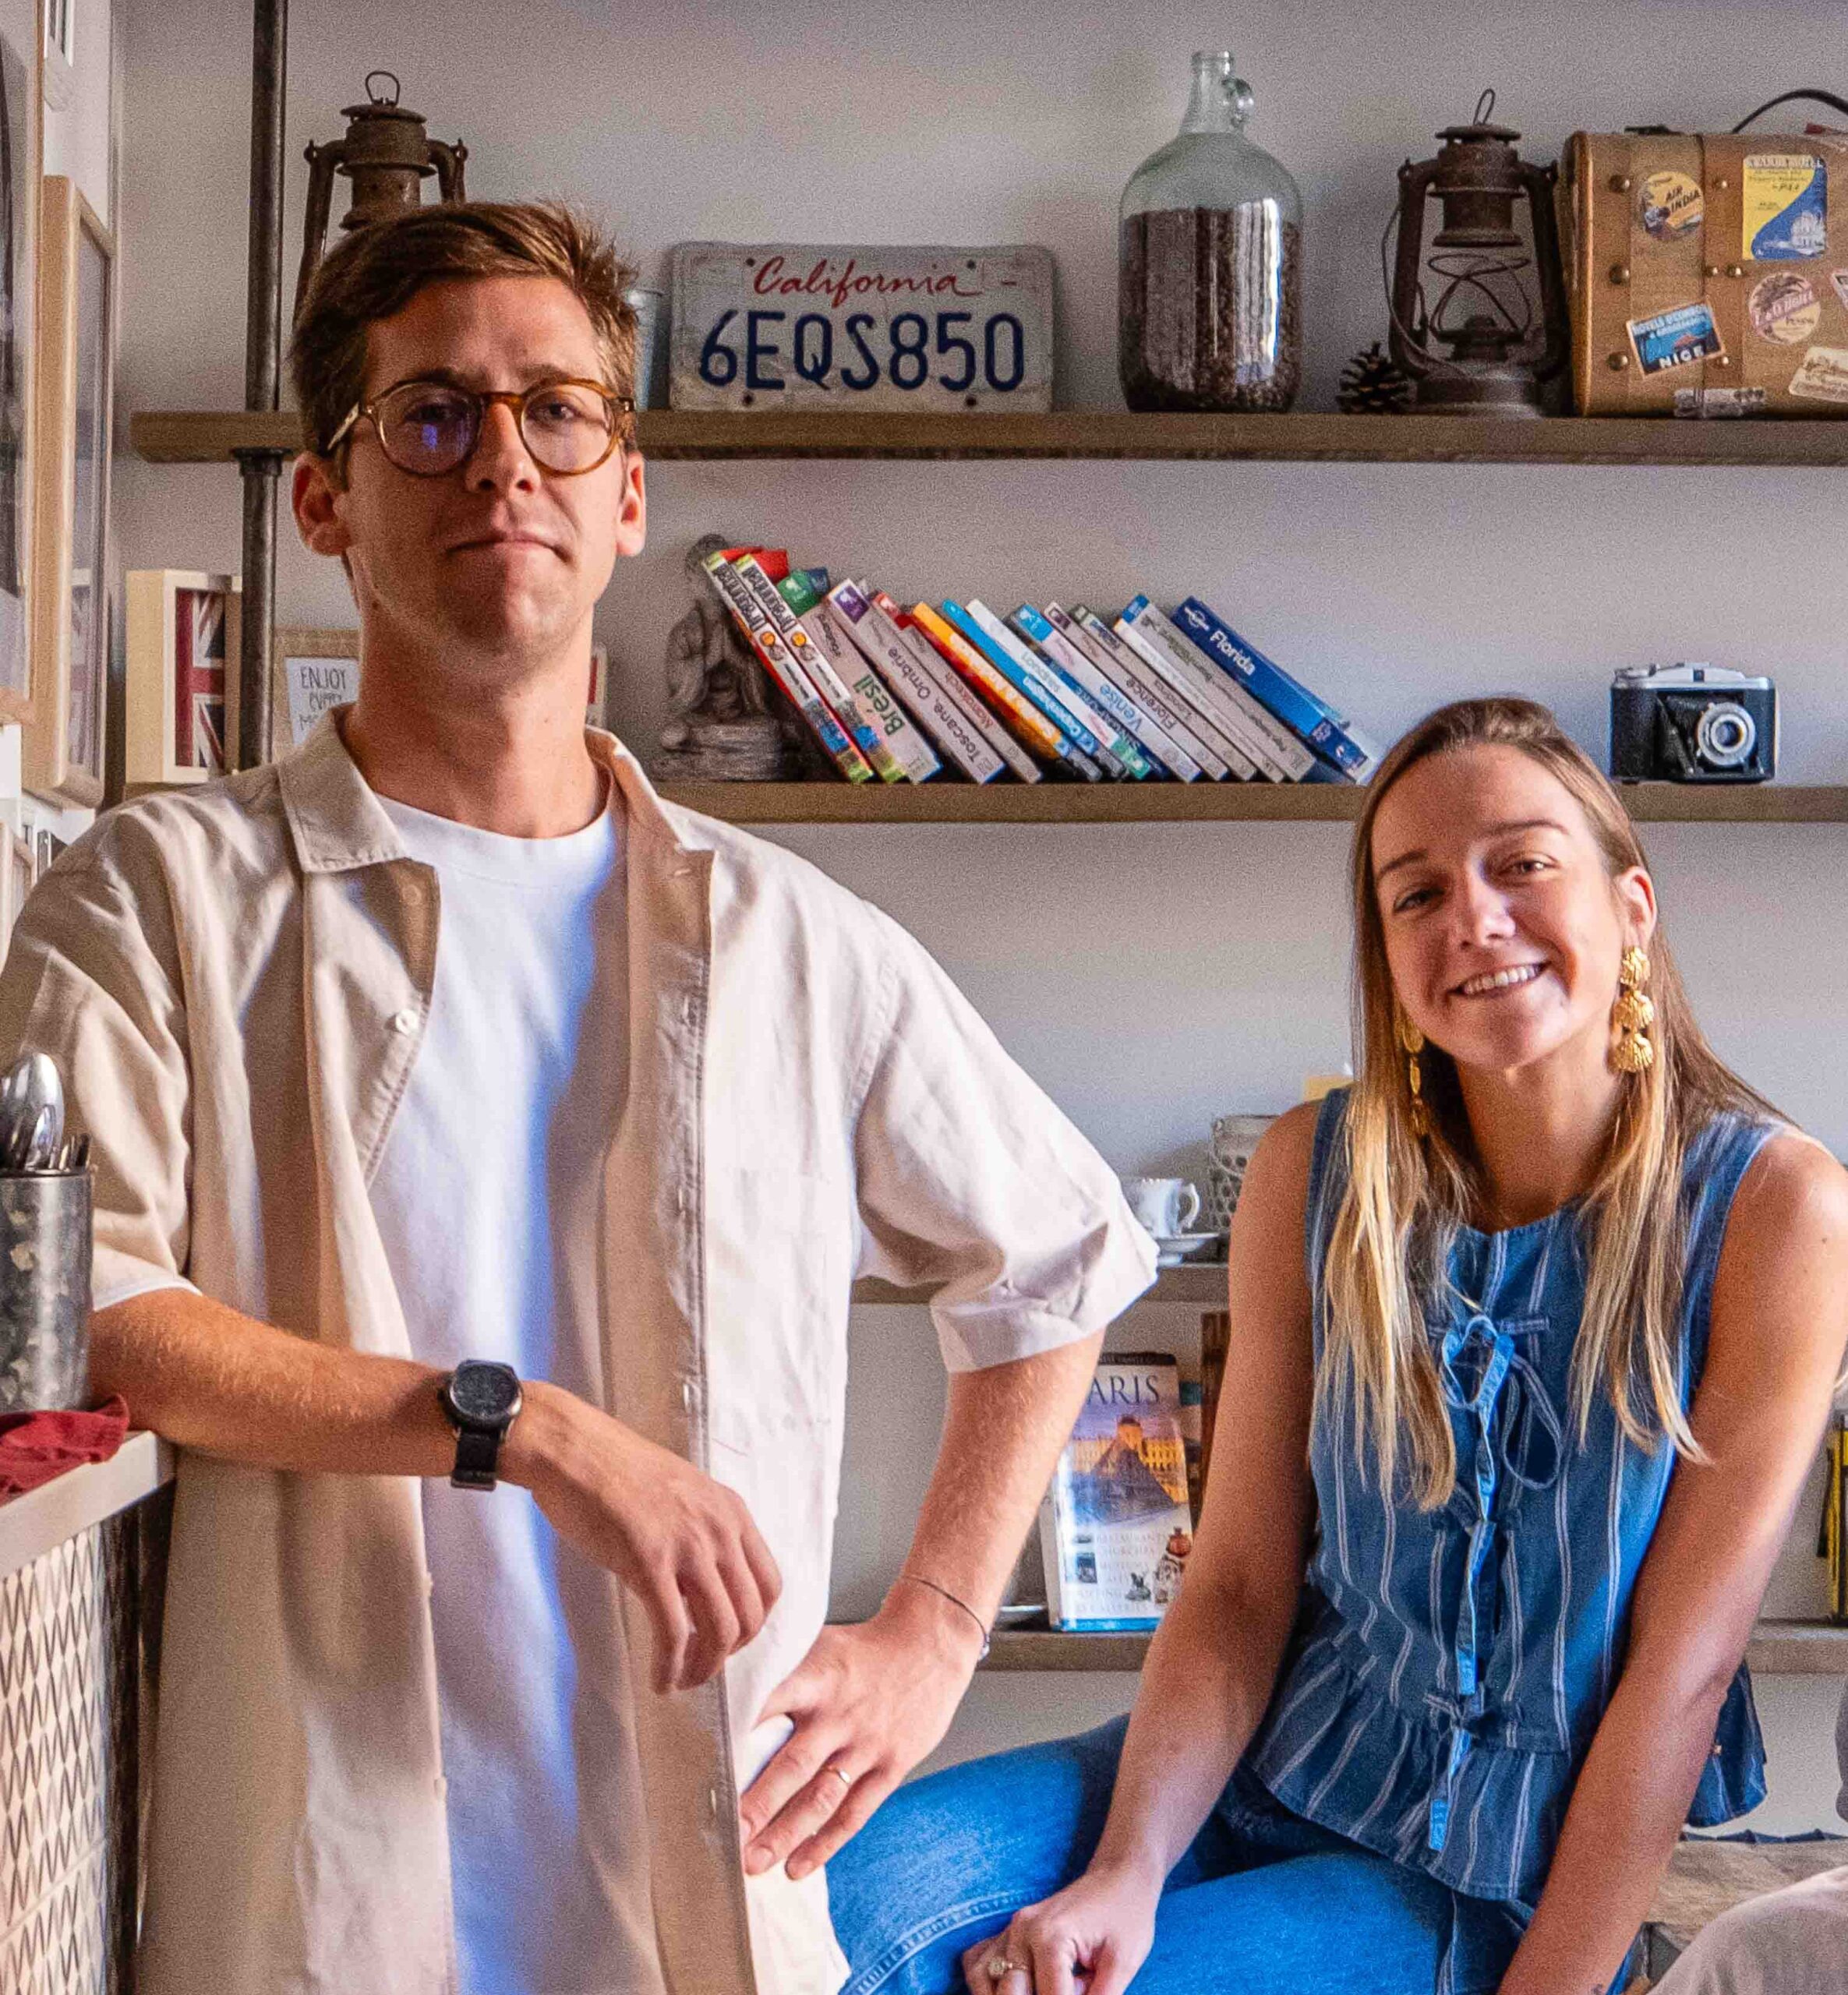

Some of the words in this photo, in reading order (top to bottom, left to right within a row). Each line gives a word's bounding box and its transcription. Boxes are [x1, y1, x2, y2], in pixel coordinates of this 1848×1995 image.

[1666, 186, 1684, 203] AIR
[1670, 190, 1701, 212] INDIA
[754, 256, 982, 309] California
[700, 309, 1023, 391] 6EQS850
[300, 666, 346, 690] ENJOY
[885, 644, 933, 701] Ombrie
[1207, 627, 1261, 677] Florida
[850, 673, 906, 738] Brésil
[940, 669, 996, 731] Marrakech
[1093, 680, 1148, 733] Venise
[1120, 675, 1179, 731] Florence
[928, 695, 984, 764] Toscane,
[1087, 1375, 1160, 1405] ARIS
